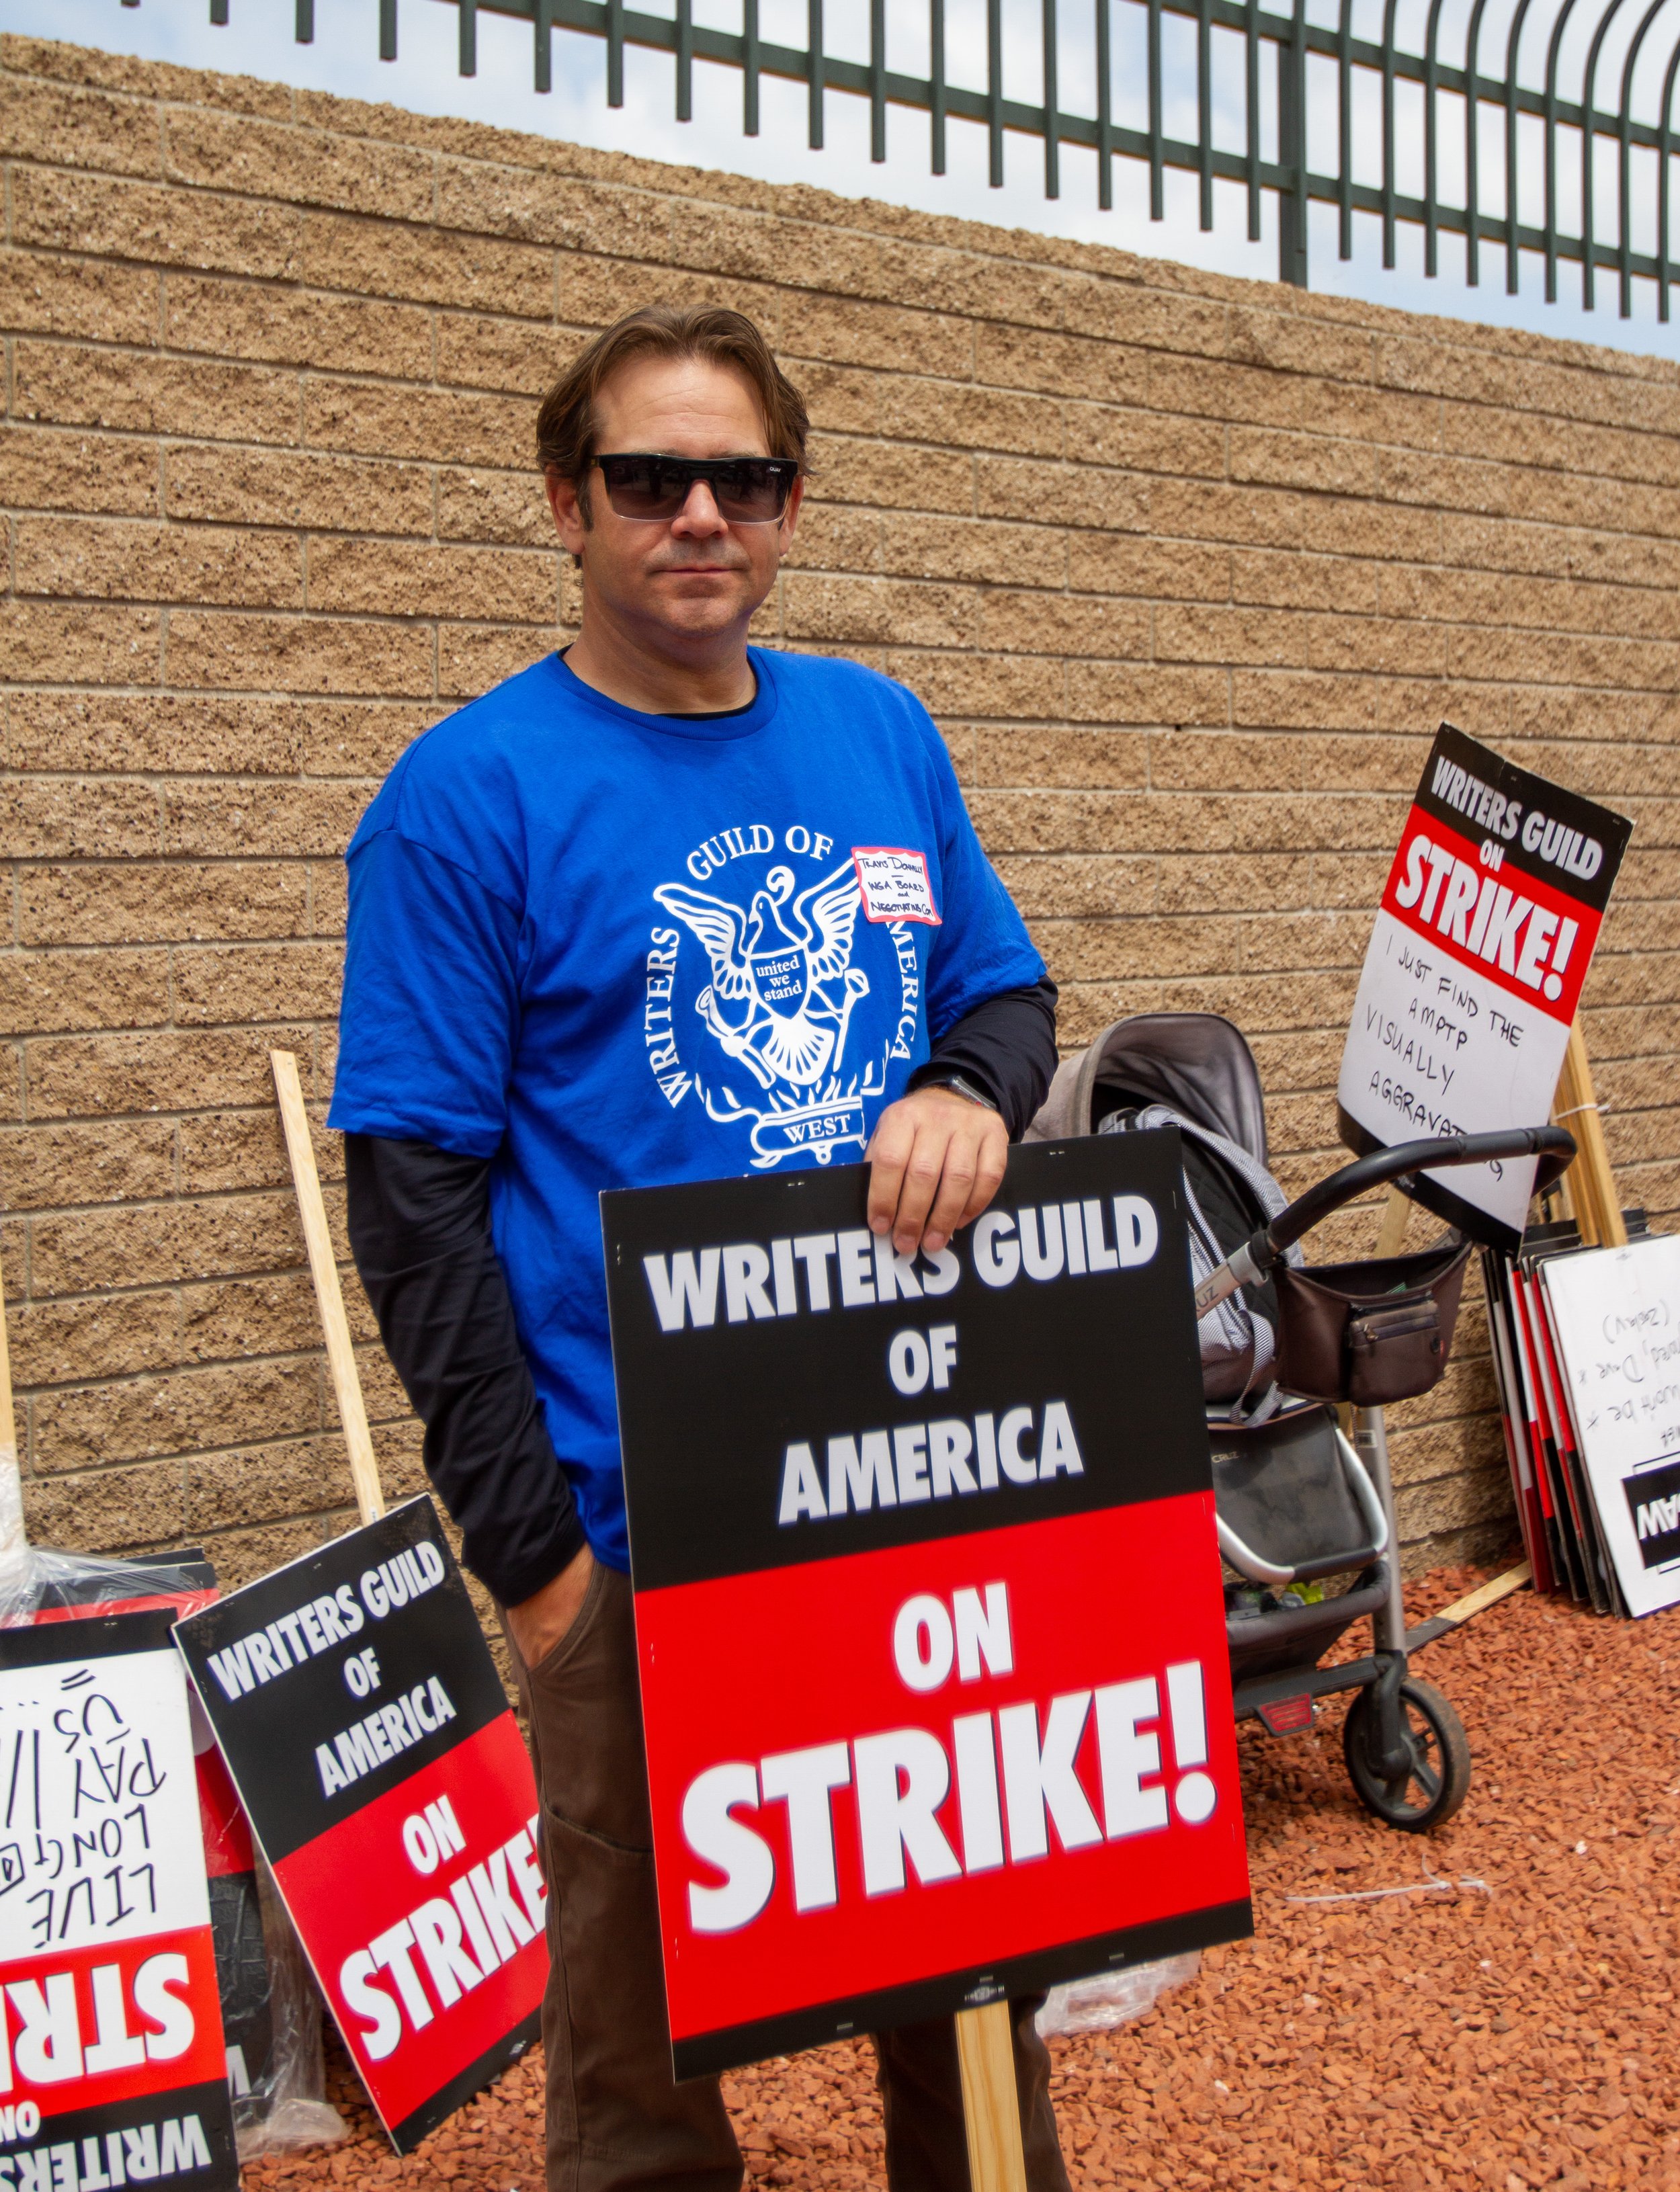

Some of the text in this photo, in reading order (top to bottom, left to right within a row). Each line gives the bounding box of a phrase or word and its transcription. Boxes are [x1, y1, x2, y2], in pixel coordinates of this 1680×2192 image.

[1431, 755, 1603, 880] WRITERS GUILD
[1480, 838, 1505, 872] ON
[857, 857, 888, 869] TRAVIS
[869, 881, 924, 892] WGA BOARD
[1395, 835, 1579, 1002] STRIKE!
[645, 825, 919, 1109] WRITERS GUILD OF MERICA
[755, 955, 800, 978] united
[763, 980, 803, 1002] stand
[769, 973, 790, 986] we
[1386, 934, 1524, 1048] I JUST FIND THE
[1367, 1003, 1455, 1096] VISUALLY
[1409, 997, 1468, 1051] AMPTP
[783, 1113, 851, 1144] WEST
[972, 1194, 1160, 1288] GUILD
[888, 1324, 958, 1396] OF
[778, 1401, 1084, 1526] AMERICA
[206, 1540, 446, 1702] WRITERS GUILD
[894, 1580, 1014, 1693] ON
[343, 1647, 382, 1698] OF
[73, 1737, 167, 1818] PAY
[314, 1675, 457, 1798] AMERICA
[402, 1794, 467, 1875] ON
[681, 1660, 1219, 1936] STRIKE!
[35, 1804, 151, 1879] LONG
[26, 1863, 156, 1949] LIVE
[339, 1813, 548, 2061] STRIKE
